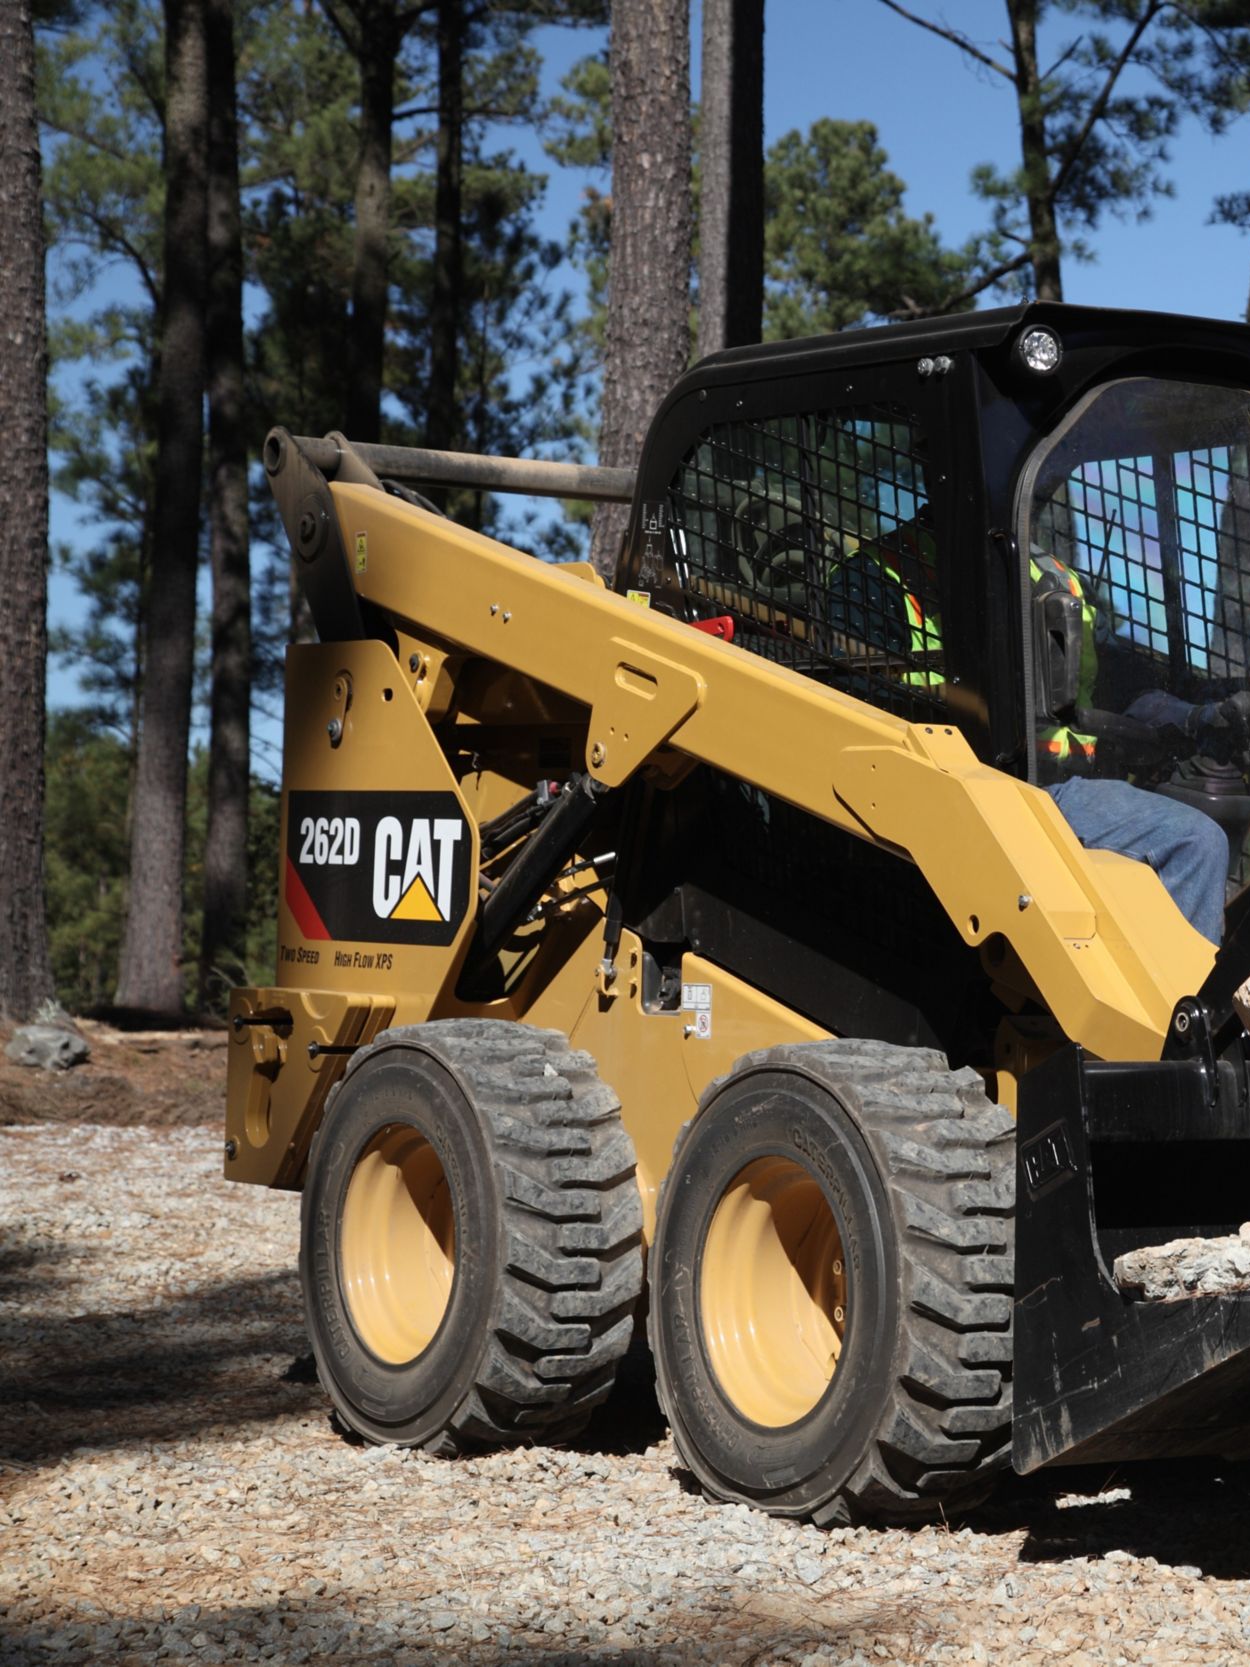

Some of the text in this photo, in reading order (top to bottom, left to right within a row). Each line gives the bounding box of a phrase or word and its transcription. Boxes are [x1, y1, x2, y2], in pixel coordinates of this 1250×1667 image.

[299, 817, 361, 866] 262D
[372, 815, 463, 923] CAT
[375, 952, 393, 970] XPS
[315, 1210, 351, 1363] CATERPILLAR
